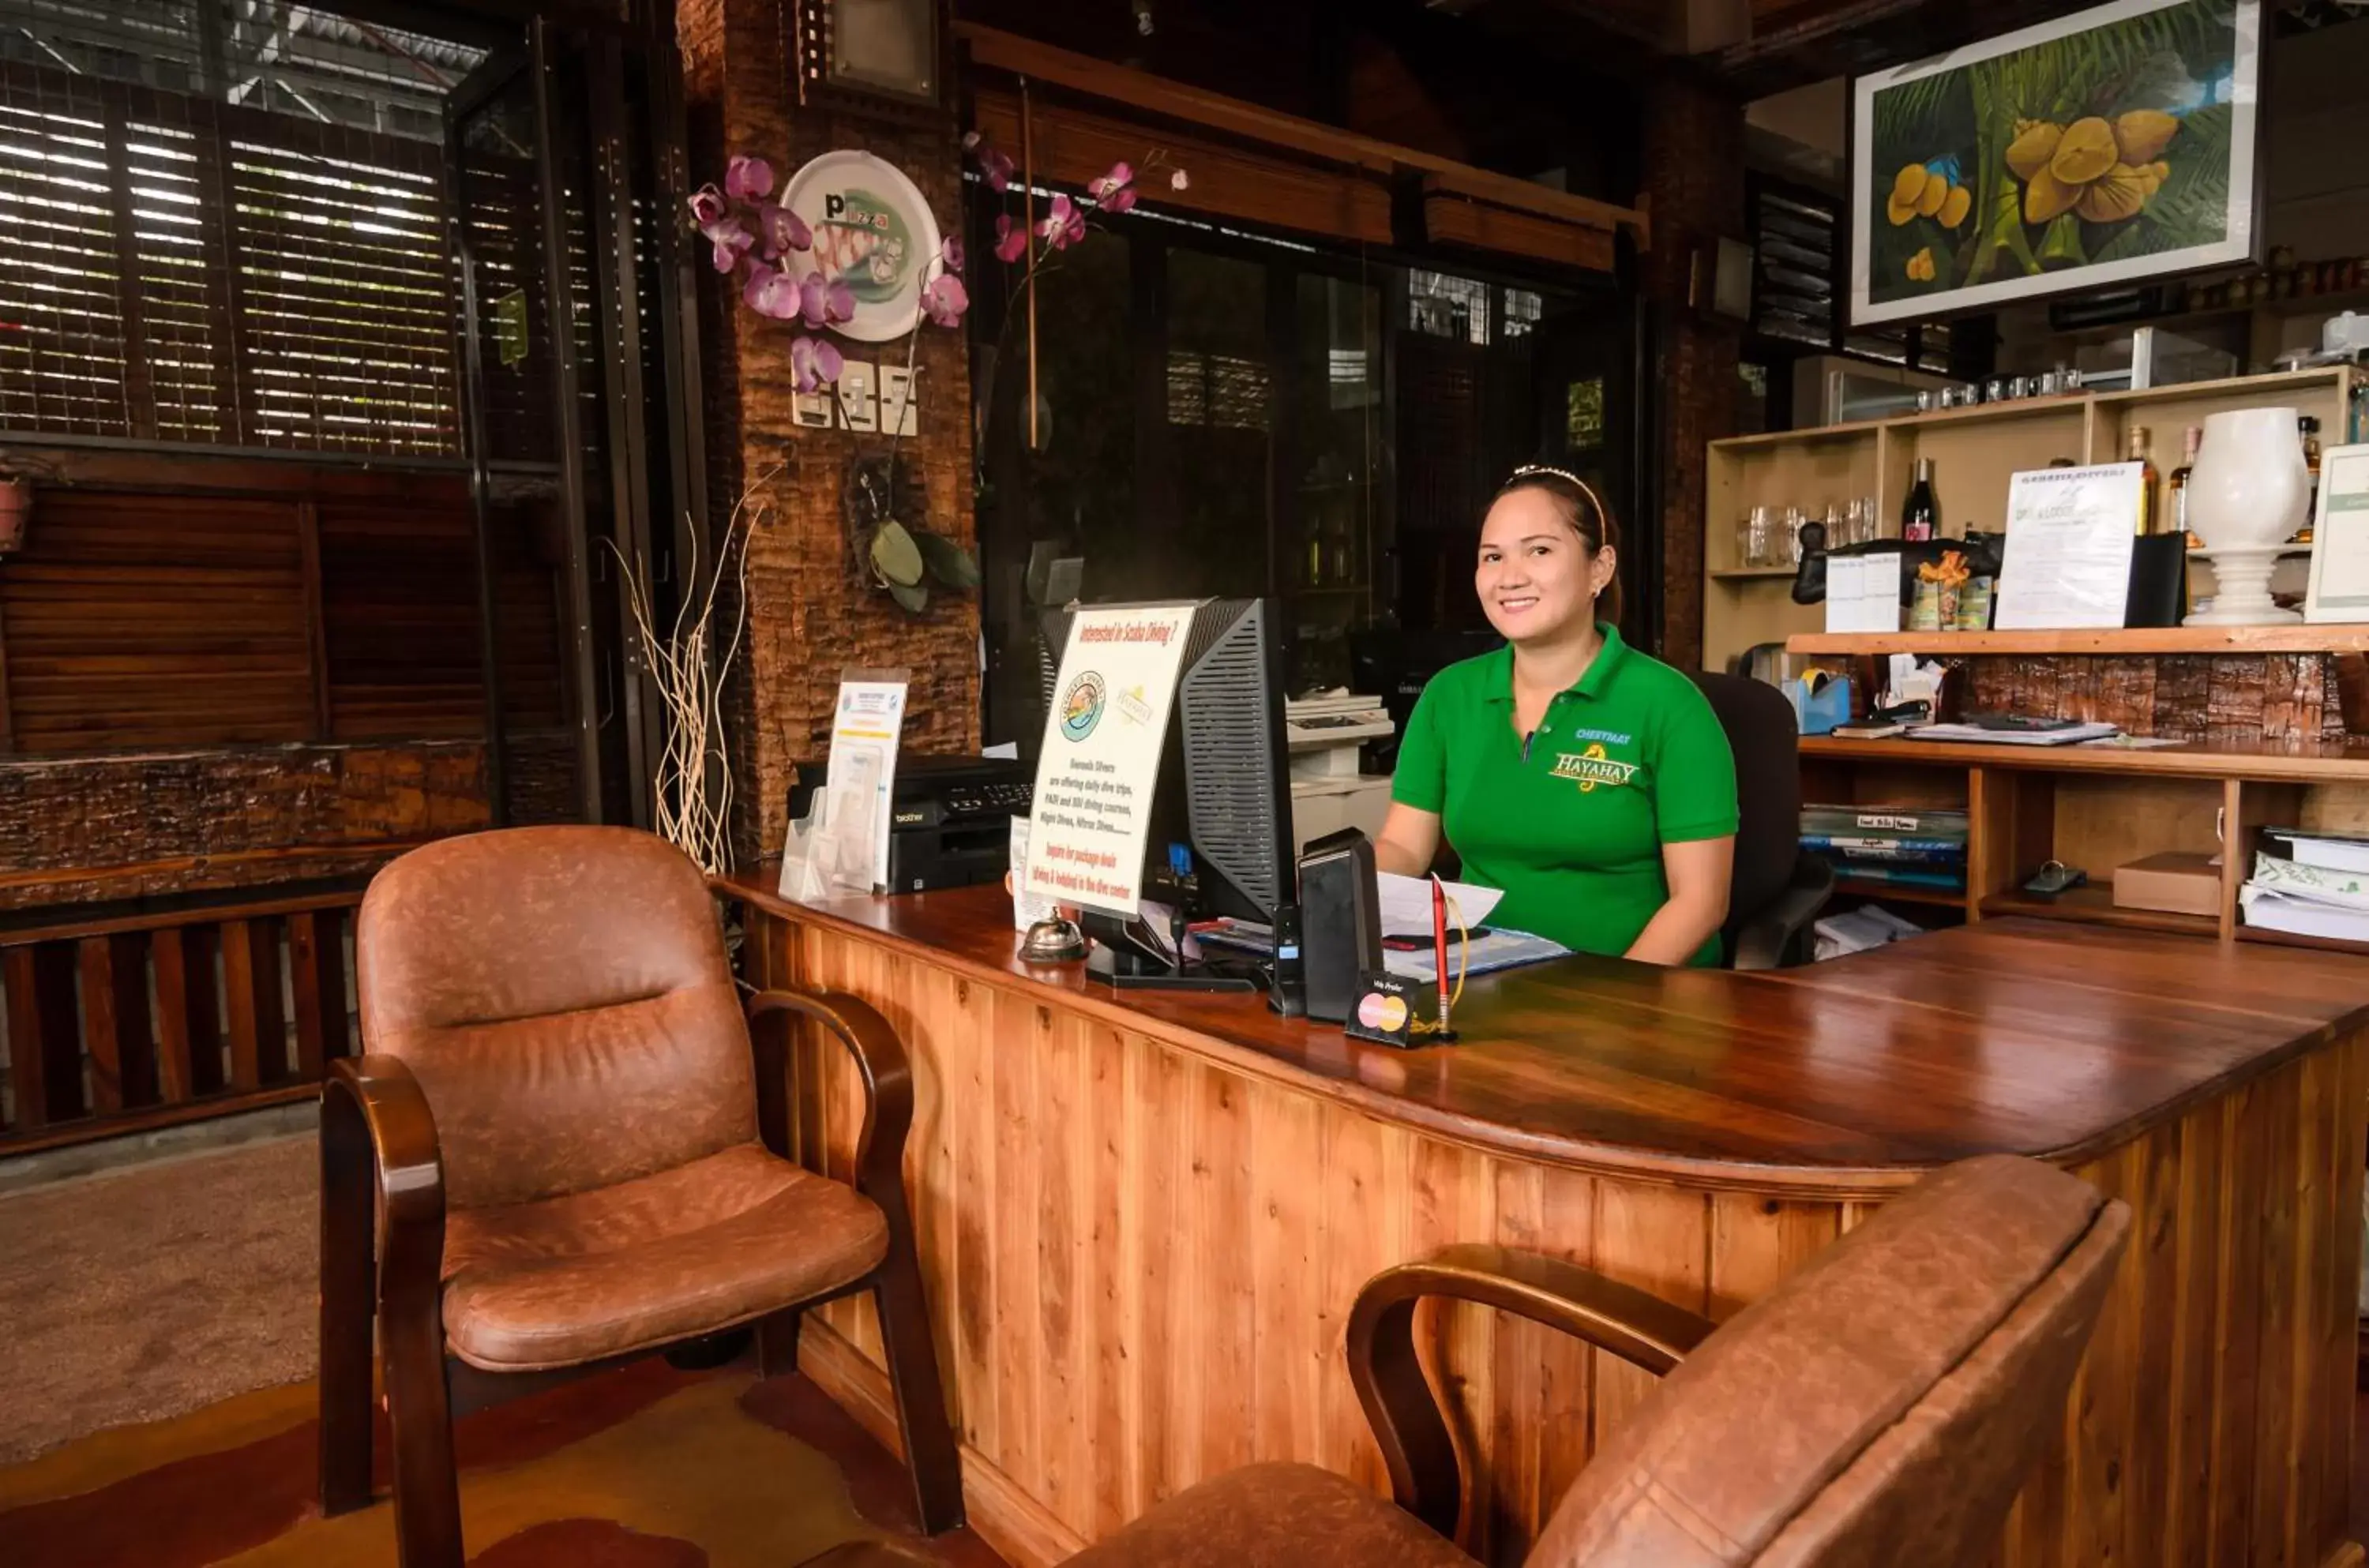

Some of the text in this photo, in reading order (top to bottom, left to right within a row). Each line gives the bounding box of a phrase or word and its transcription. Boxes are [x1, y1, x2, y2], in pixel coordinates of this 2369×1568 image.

[1079, 621, 1117, 643] Interested
[1123, 621, 1144, 641] Scuba
[1144, 620, 1170, 647] Diving
[1556, 755, 1636, 782] HAYAHAY
[1061, 777, 1083, 792] offering
[1085, 780, 1099, 793] daily
[895, 813, 923, 823] brother
